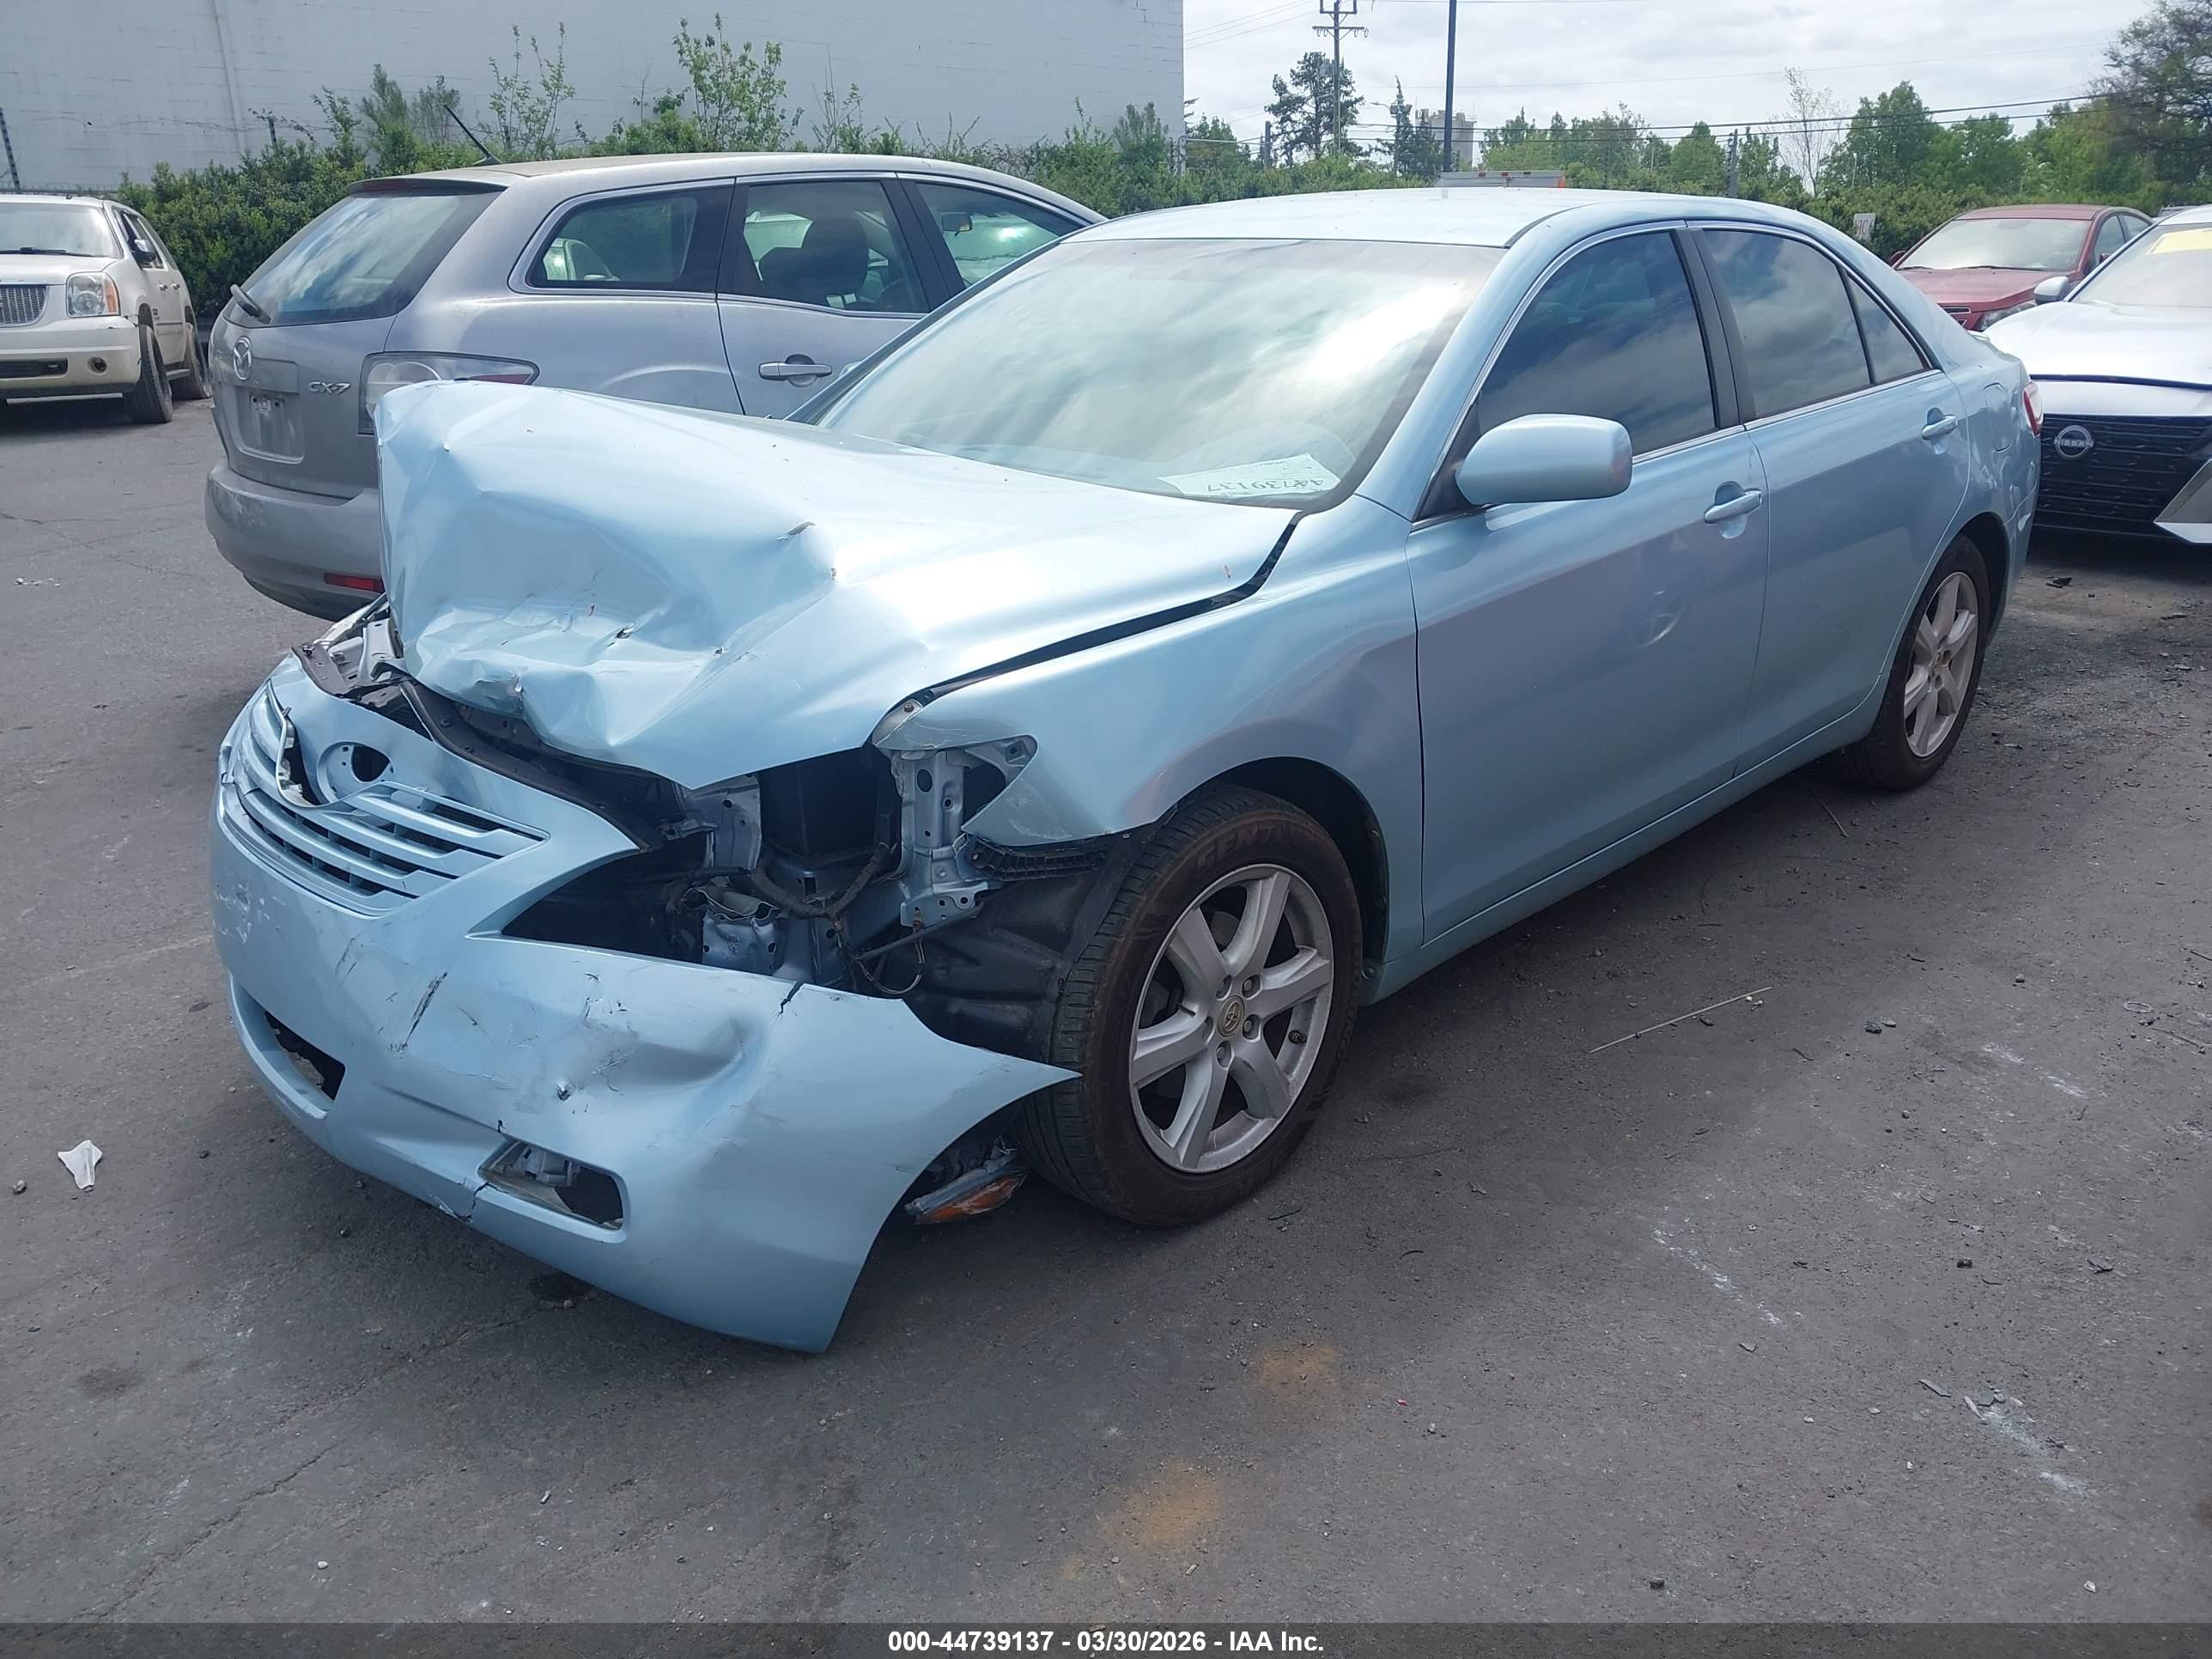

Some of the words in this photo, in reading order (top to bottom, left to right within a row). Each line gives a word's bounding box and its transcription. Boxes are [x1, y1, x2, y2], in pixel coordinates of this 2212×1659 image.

[309, 381, 350, 395] CX-7
[2054, 437, 2094, 447] NISSAN
[1207, 479, 1324, 492] 44739137
